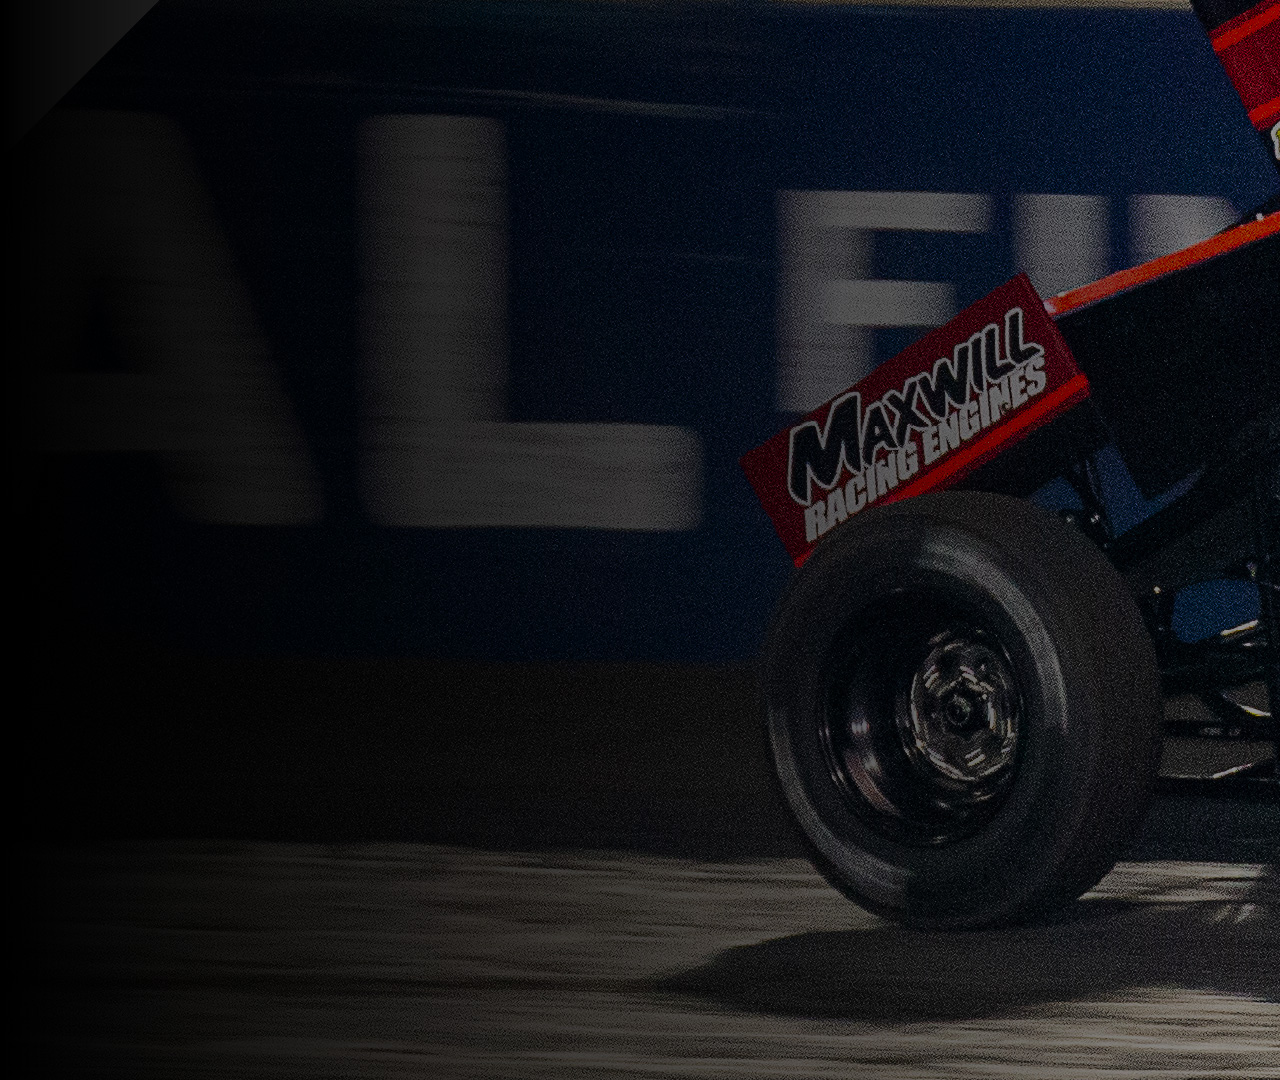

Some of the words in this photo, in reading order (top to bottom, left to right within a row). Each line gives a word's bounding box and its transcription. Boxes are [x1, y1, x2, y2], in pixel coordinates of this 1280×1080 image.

[787, 306, 1045, 507] MAXWILL
[803, 447, 921, 544] RACING
[923, 354, 1049, 470] ENGINES
